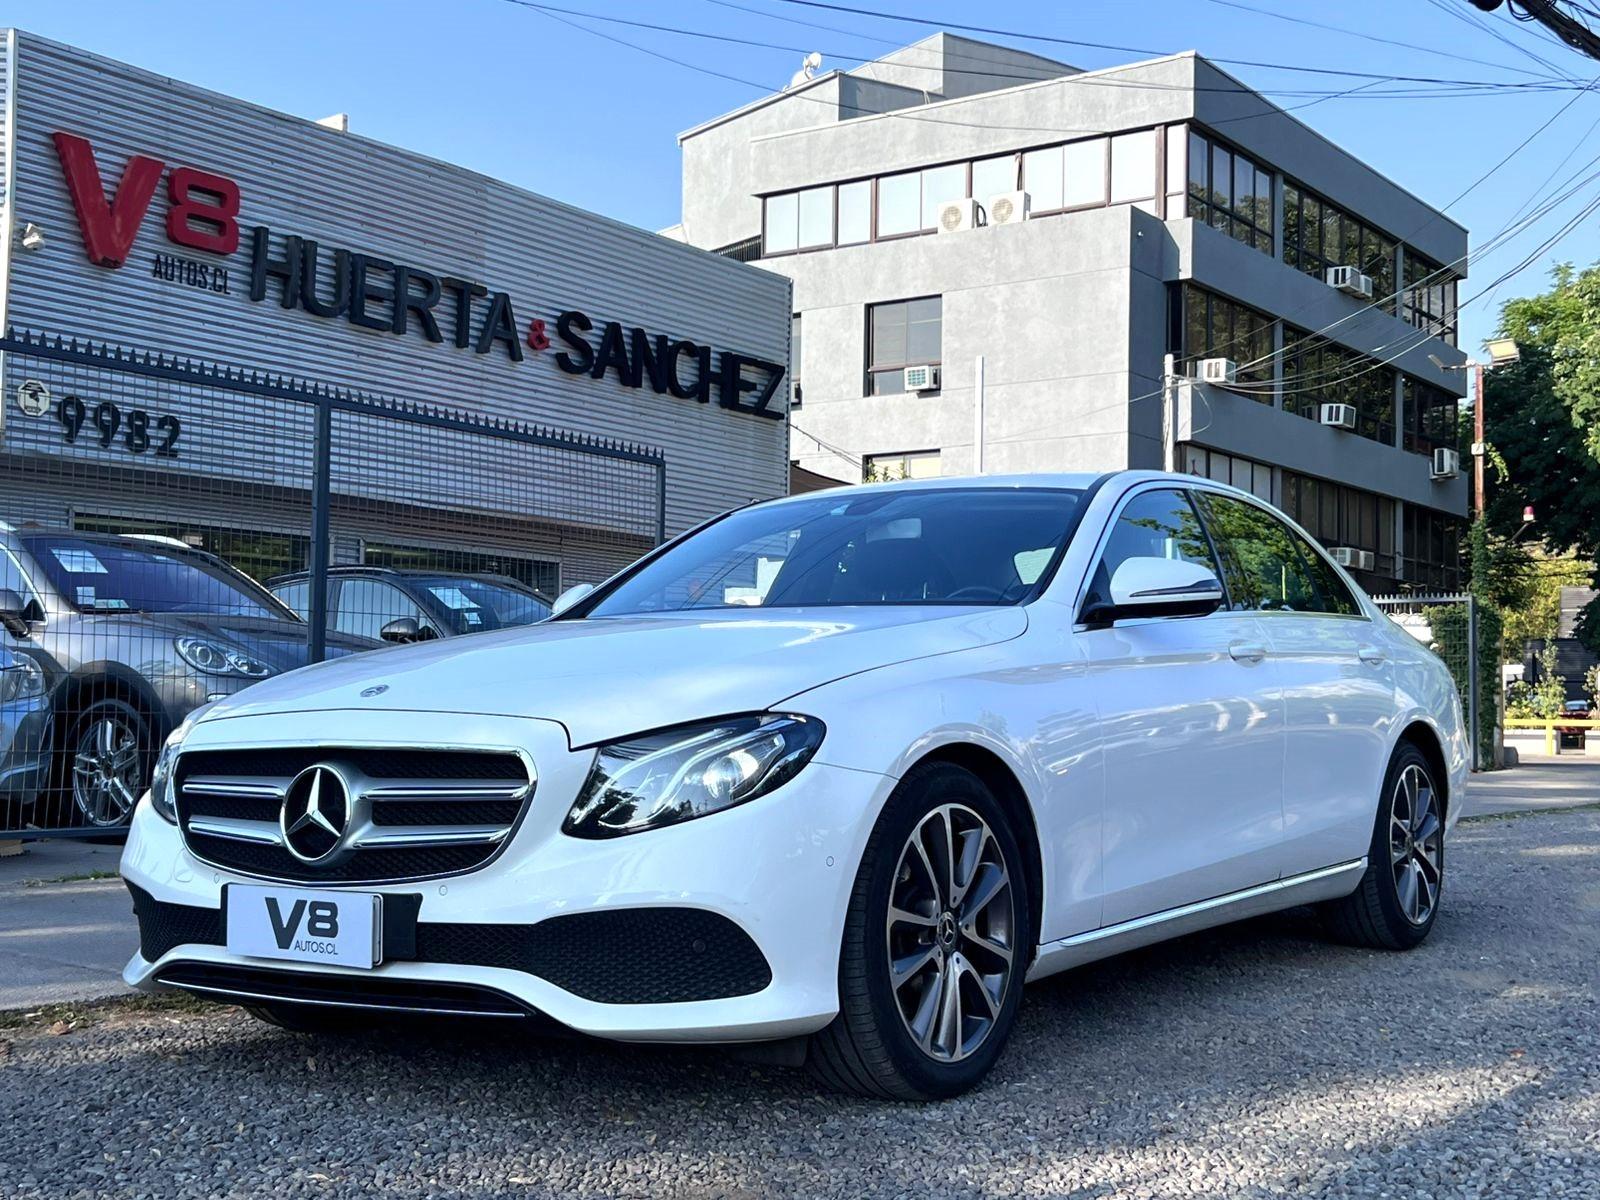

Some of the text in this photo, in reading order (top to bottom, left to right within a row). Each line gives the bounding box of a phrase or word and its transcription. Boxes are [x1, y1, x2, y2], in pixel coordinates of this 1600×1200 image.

[53, 132, 240, 269] V8
[152, 253, 231, 295] AUTOS.CL
[249, 226, 786, 420] HUERTA & SANCHEZ
[58, 395, 181, 459] 9982
[265, 897, 339, 950] V8
[294, 940, 338, 956] AUTOS.CL
